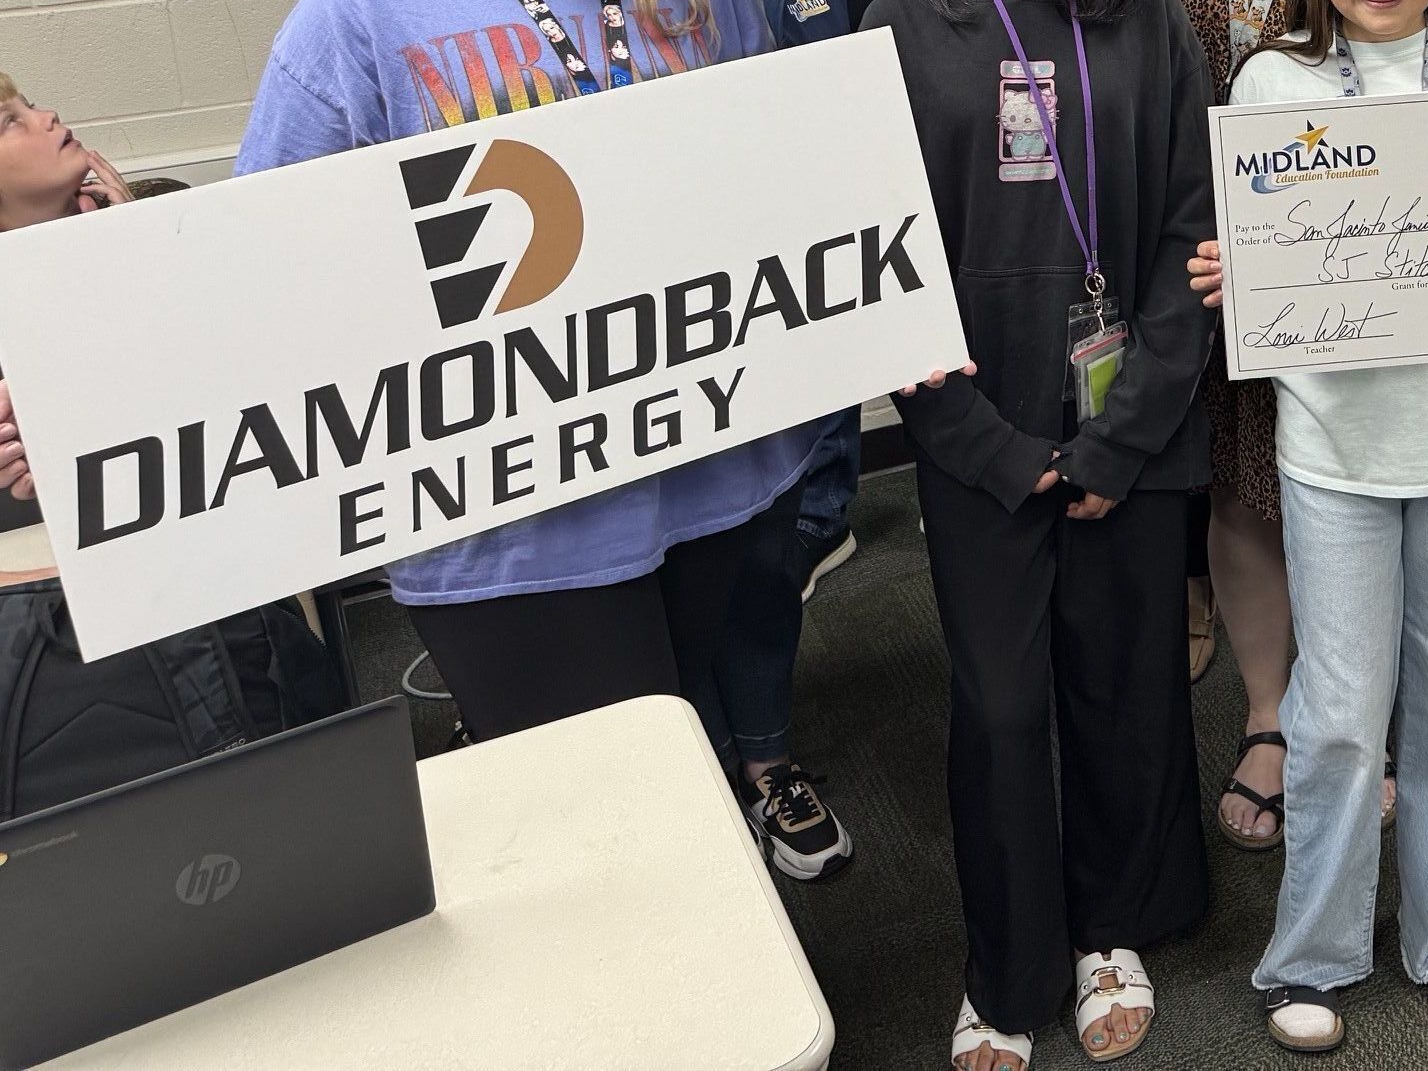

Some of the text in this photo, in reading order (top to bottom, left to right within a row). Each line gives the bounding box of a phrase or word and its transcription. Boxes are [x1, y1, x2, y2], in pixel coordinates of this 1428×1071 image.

[1235, 144, 1377, 177] MIDLAND
[1275, 167, 1379, 184] Education Foundation
[1235, 222, 1276, 234] Pay to the
[1274, 199, 1324, 246] San
[1236, 235, 1272, 246] Order of
[1318, 252, 1368, 282] SJ
[1391, 281, 1415, 291] Grant
[1417, 280, 1428, 289] for
[1314, 301, 1398, 342] West
[1304, 345, 1335, 355] Teacher
[76, 213, 925, 549] DIAMONDBACK
[338, 367, 746, 556] ENERGY
[179, 854, 239, 905] hp
